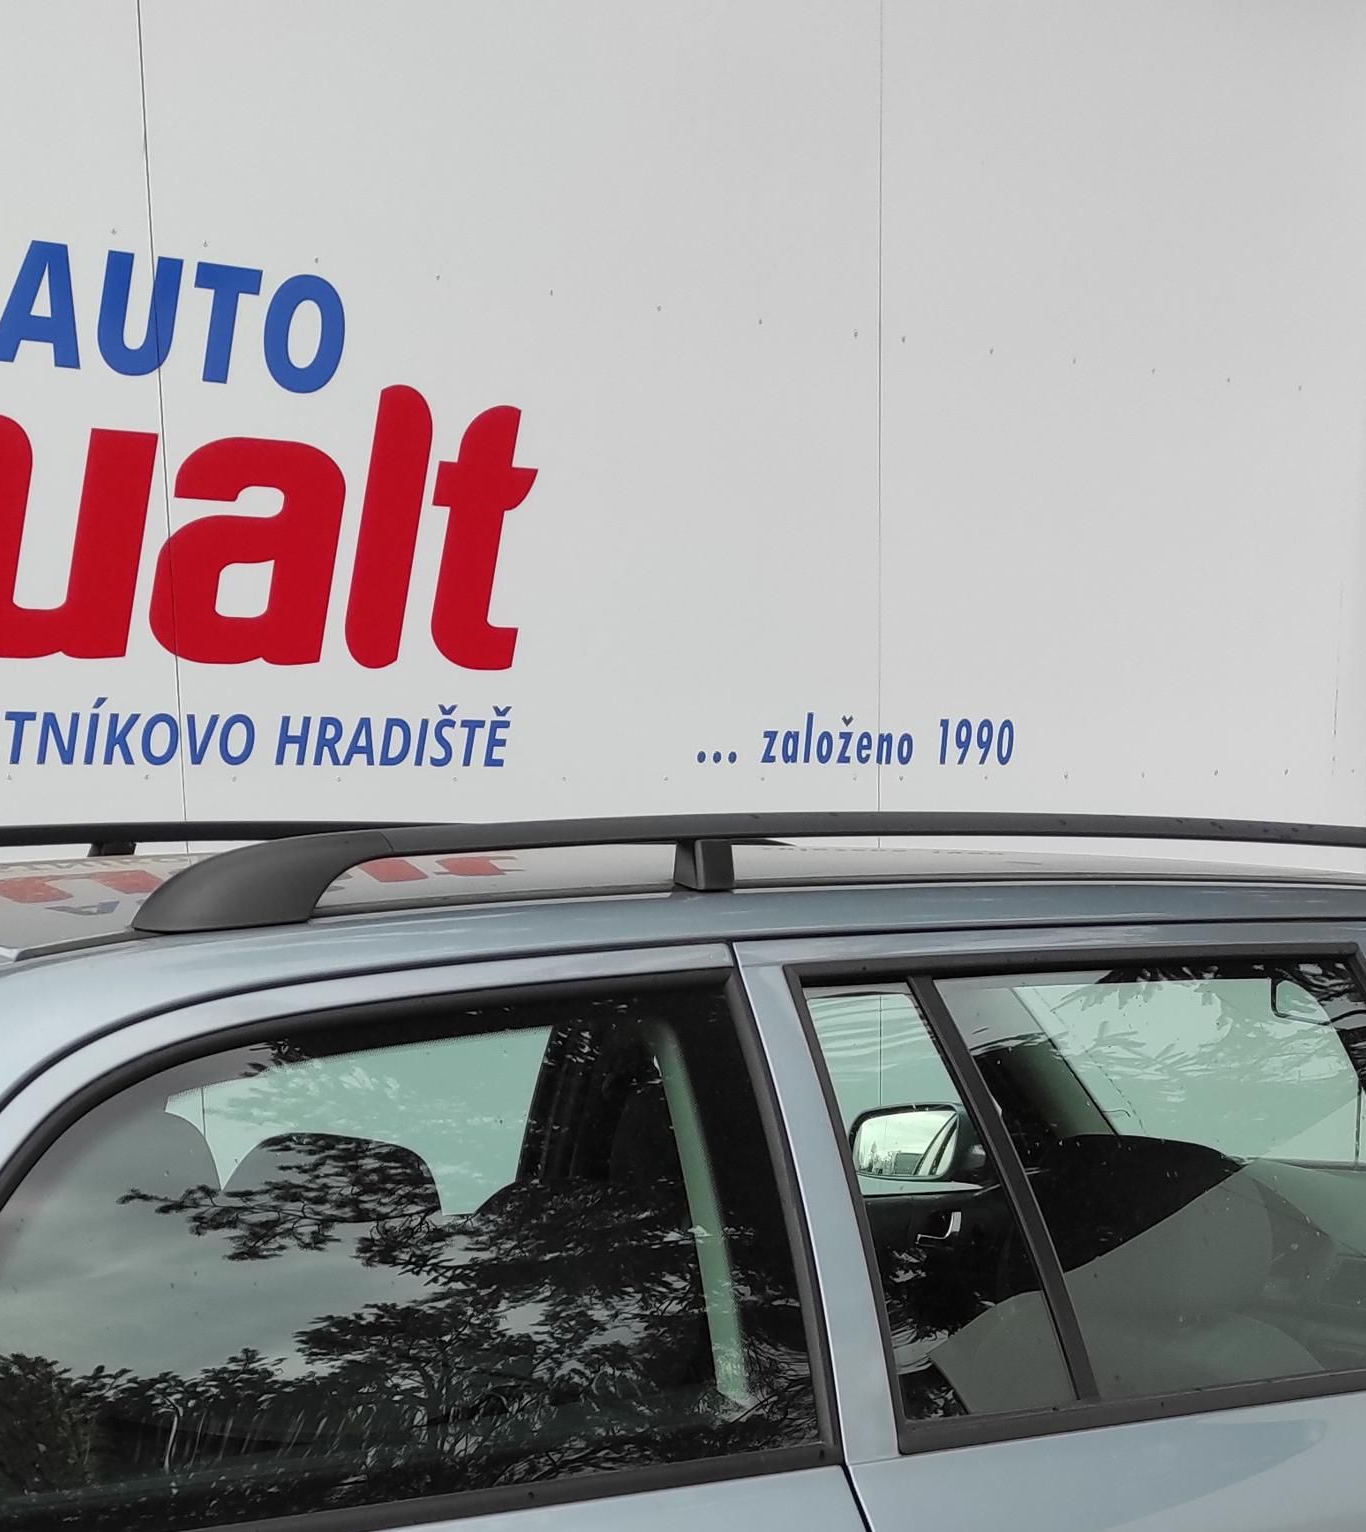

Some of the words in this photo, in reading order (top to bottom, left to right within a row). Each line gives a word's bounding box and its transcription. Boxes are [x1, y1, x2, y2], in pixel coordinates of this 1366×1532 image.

[274, 704, 513, 769] HRADIŠTĚ
[760, 712, 914, 766] založeno
[938, 718, 1015, 766] 1990
